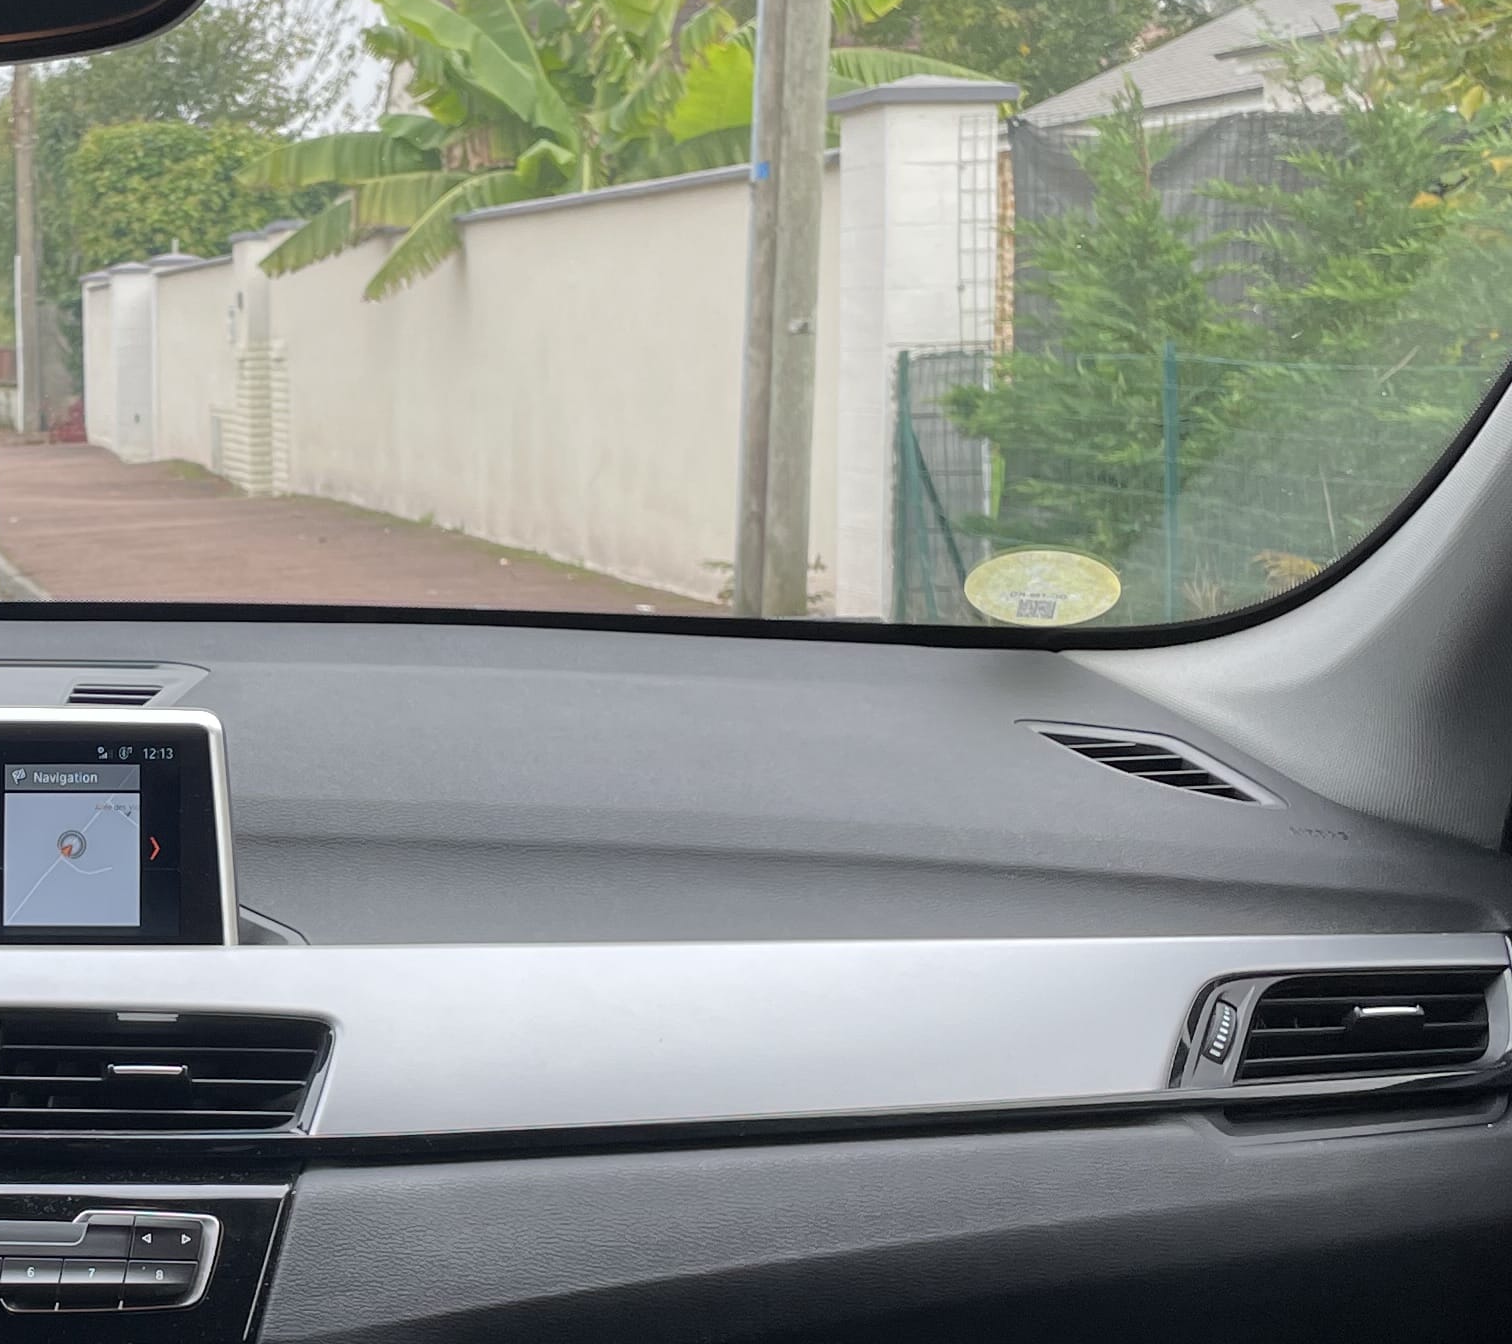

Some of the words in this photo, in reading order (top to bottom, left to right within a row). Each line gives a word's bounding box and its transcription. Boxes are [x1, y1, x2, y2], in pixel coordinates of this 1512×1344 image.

[143, 748, 174, 760] 12:13
[33, 772, 98, 786] Navigation
[26, 1266, 35, 1278] 6
[88, 1267, 96, 1279] 7
[154, 1269, 164, 1281] 8
